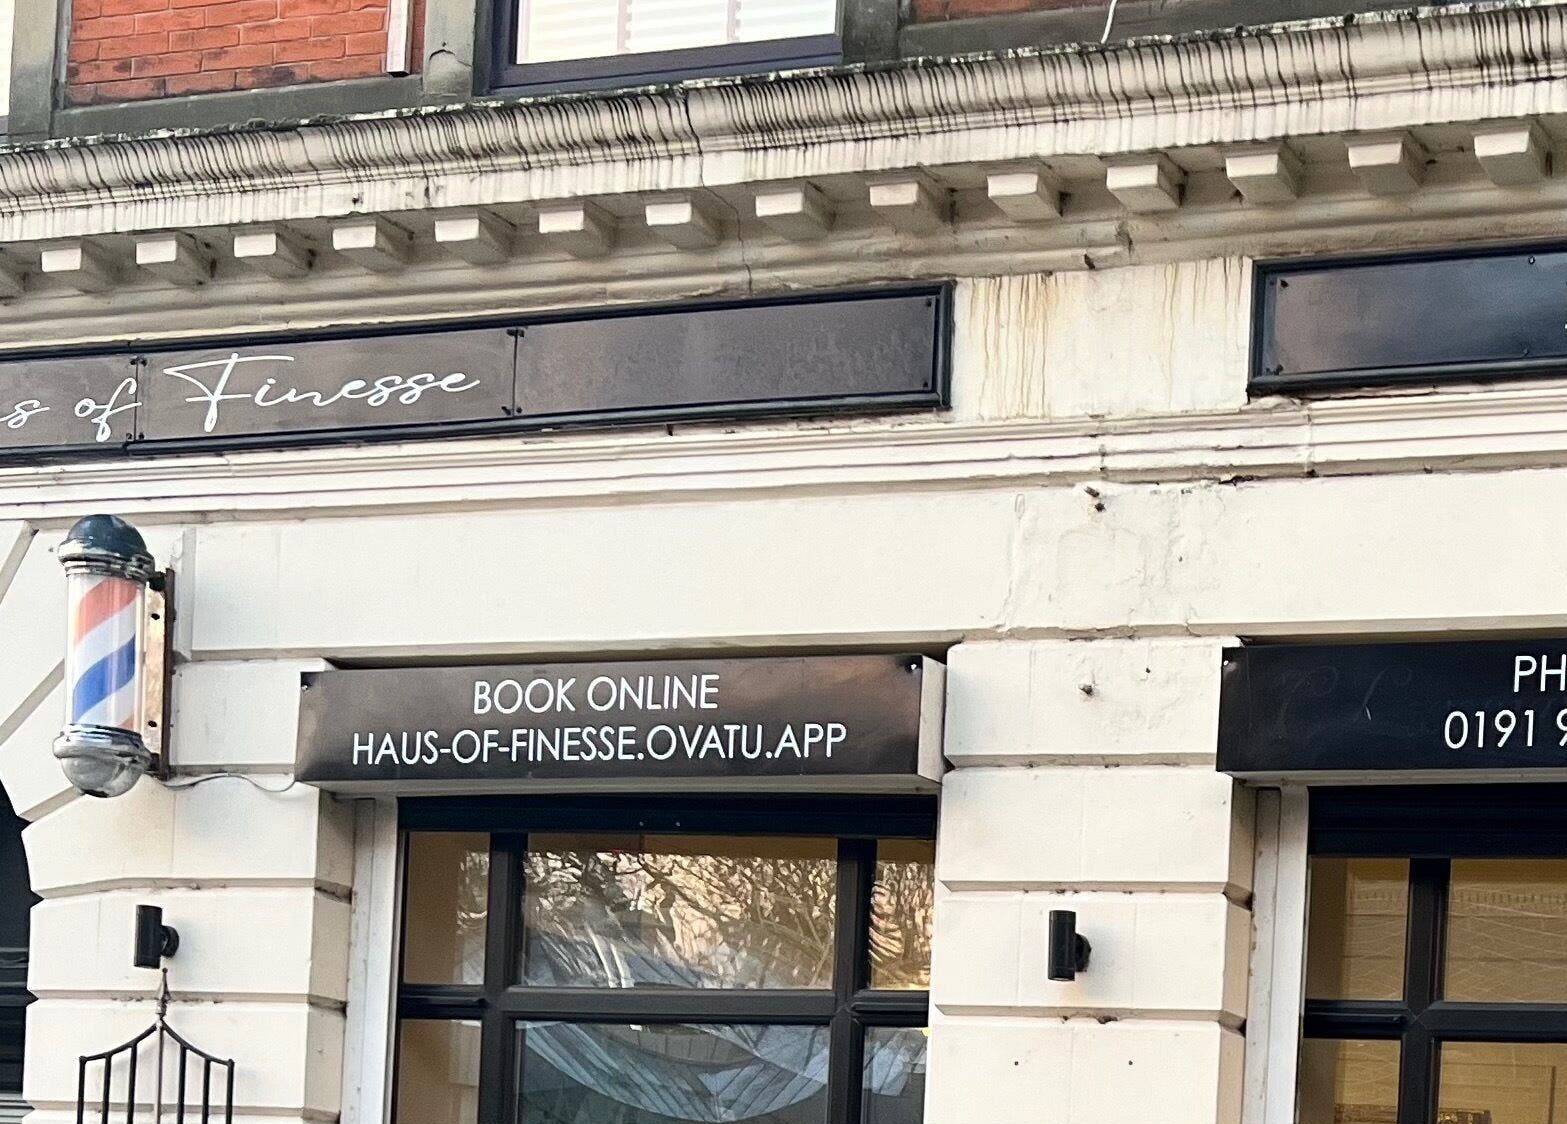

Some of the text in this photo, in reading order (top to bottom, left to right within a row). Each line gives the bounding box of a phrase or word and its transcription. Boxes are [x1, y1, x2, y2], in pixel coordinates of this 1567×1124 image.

[75, 377, 142, 442] of
[163, 352, 479, 432] Finesse
[473, 674, 720, 714] BOOK ONLINE
[352, 723, 847, 765] HAUS-OF-FINESSE.OVATU.APP
[1444, 709, 1534, 749] 0191
